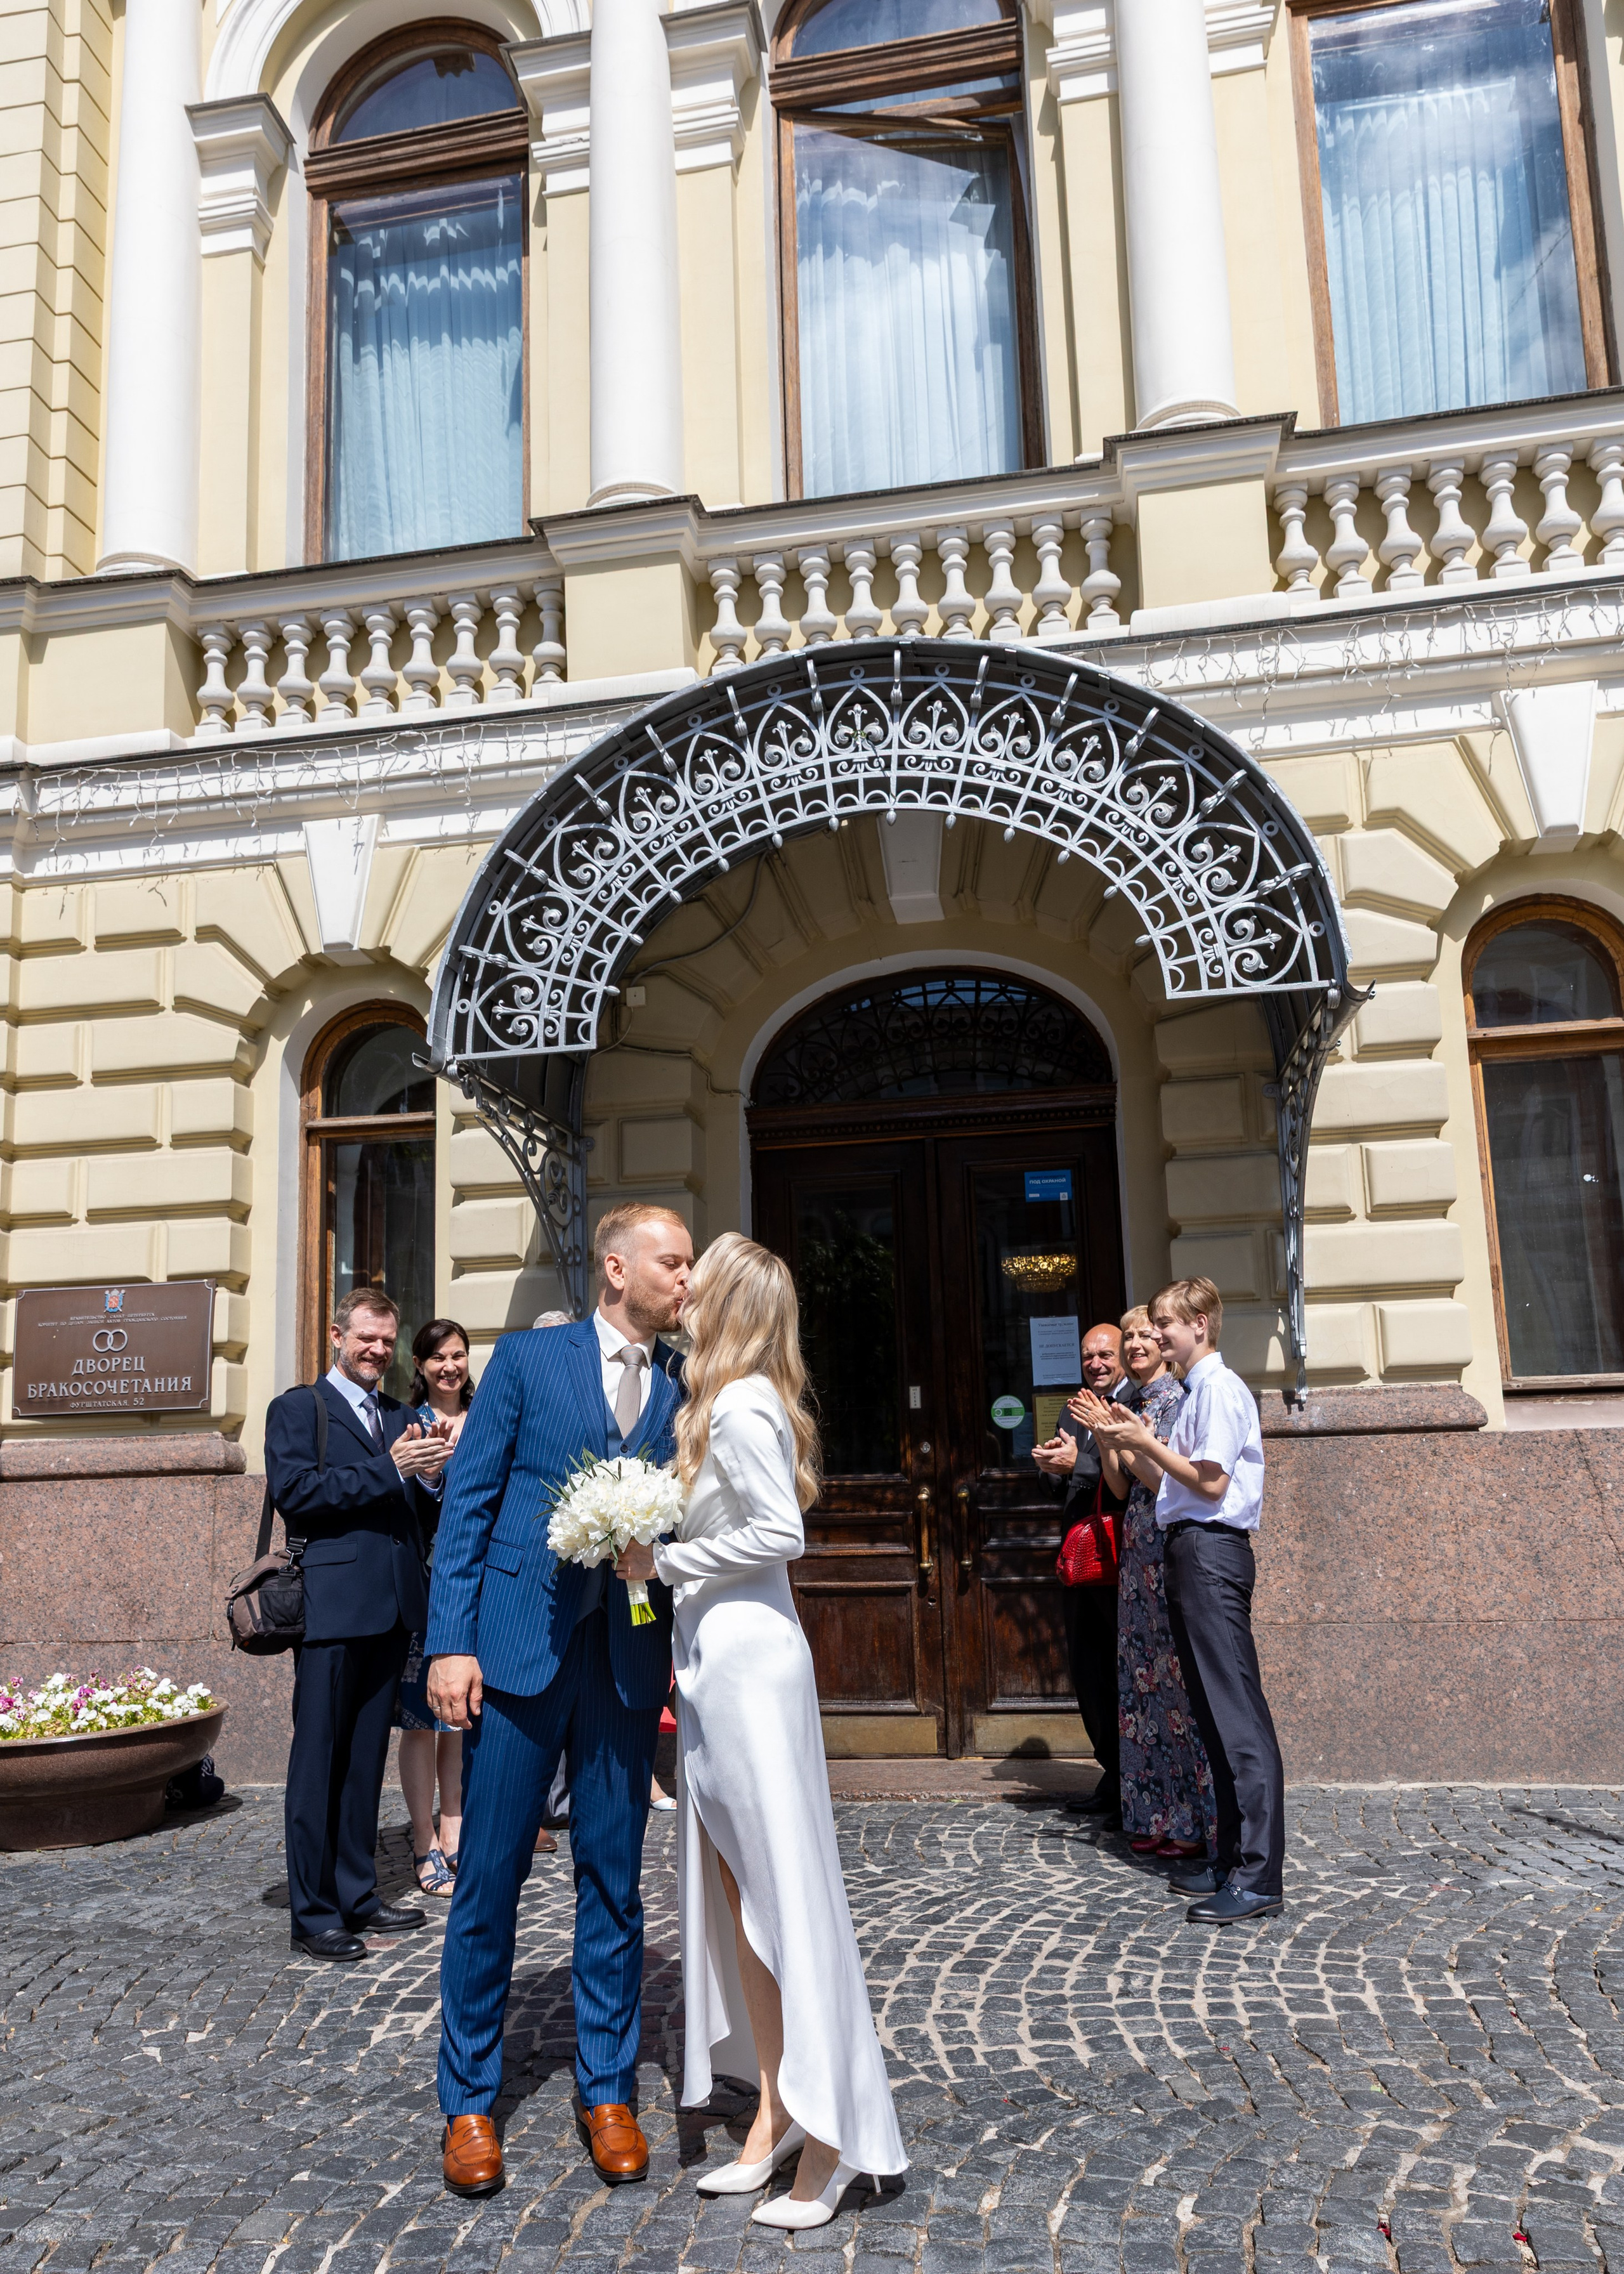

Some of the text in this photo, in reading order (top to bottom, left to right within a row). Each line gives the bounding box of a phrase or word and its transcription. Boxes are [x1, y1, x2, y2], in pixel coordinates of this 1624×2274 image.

[71, 1356, 145, 1376] ДВОРЕЦ
[27, 1376, 192, 1399] БРАКОСОЧЕТАНИЯ
[133, 1397, 145, 1406] 52
